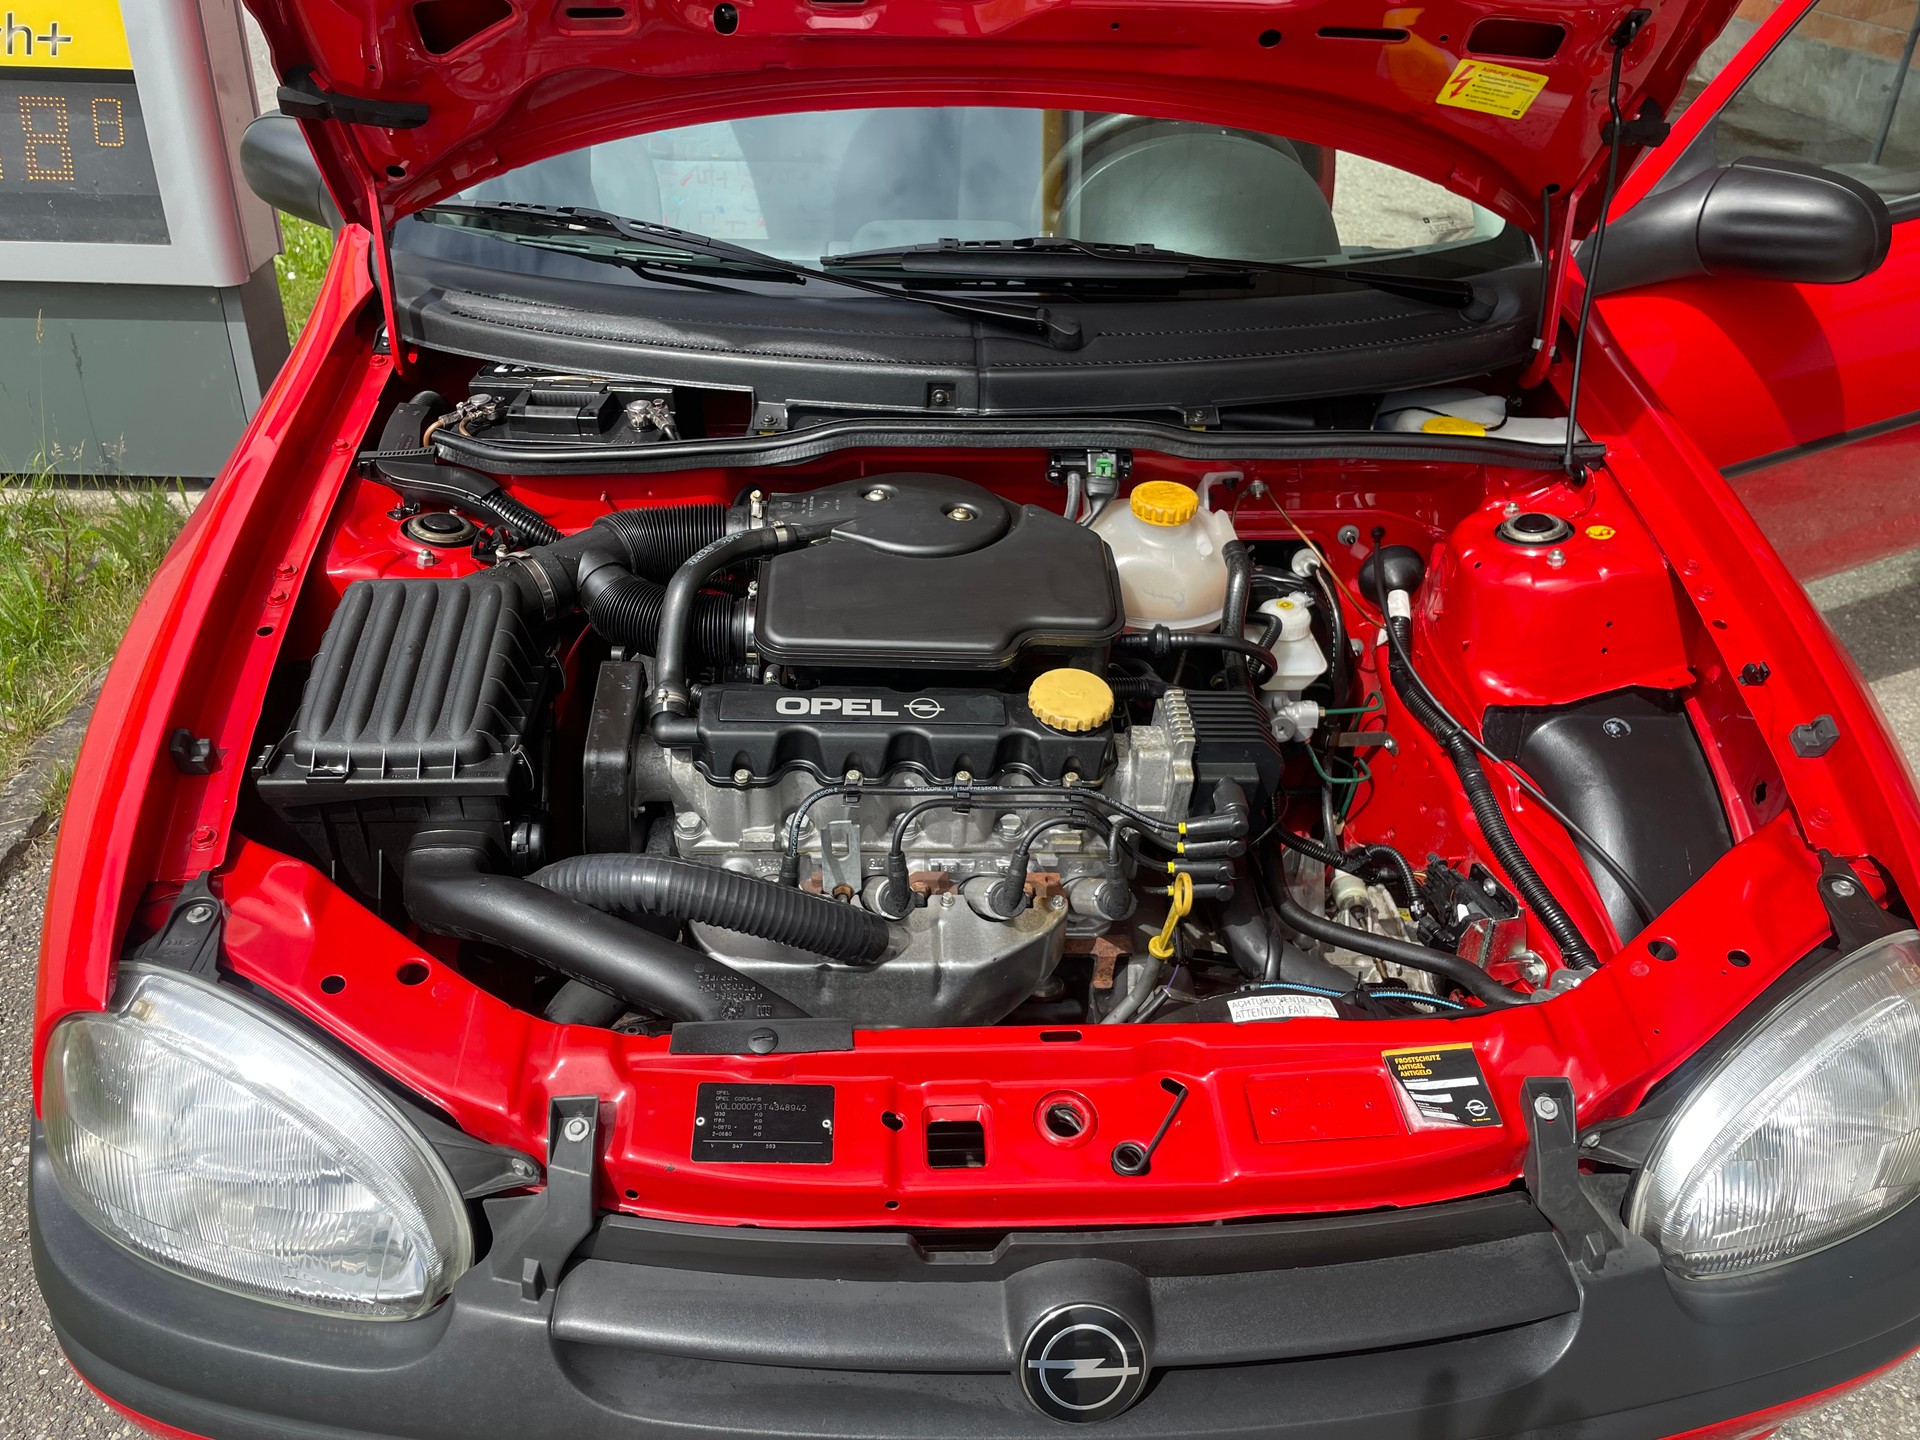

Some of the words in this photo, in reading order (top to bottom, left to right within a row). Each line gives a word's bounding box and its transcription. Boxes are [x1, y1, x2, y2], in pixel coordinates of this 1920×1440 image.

[0, 12, 72, 57] h+
[775, 697, 899, 716] OPEL
[1232, 997, 1277, 1009] ACHTUNG
[1235, 1006, 1285, 1020] ATTENTION
[1394, 1054, 1441, 1064] FROSTSCHUTZ
[1397, 1063, 1426, 1071] ANTIGEL
[1400, 1069, 1433, 1077] ANTIGELO
